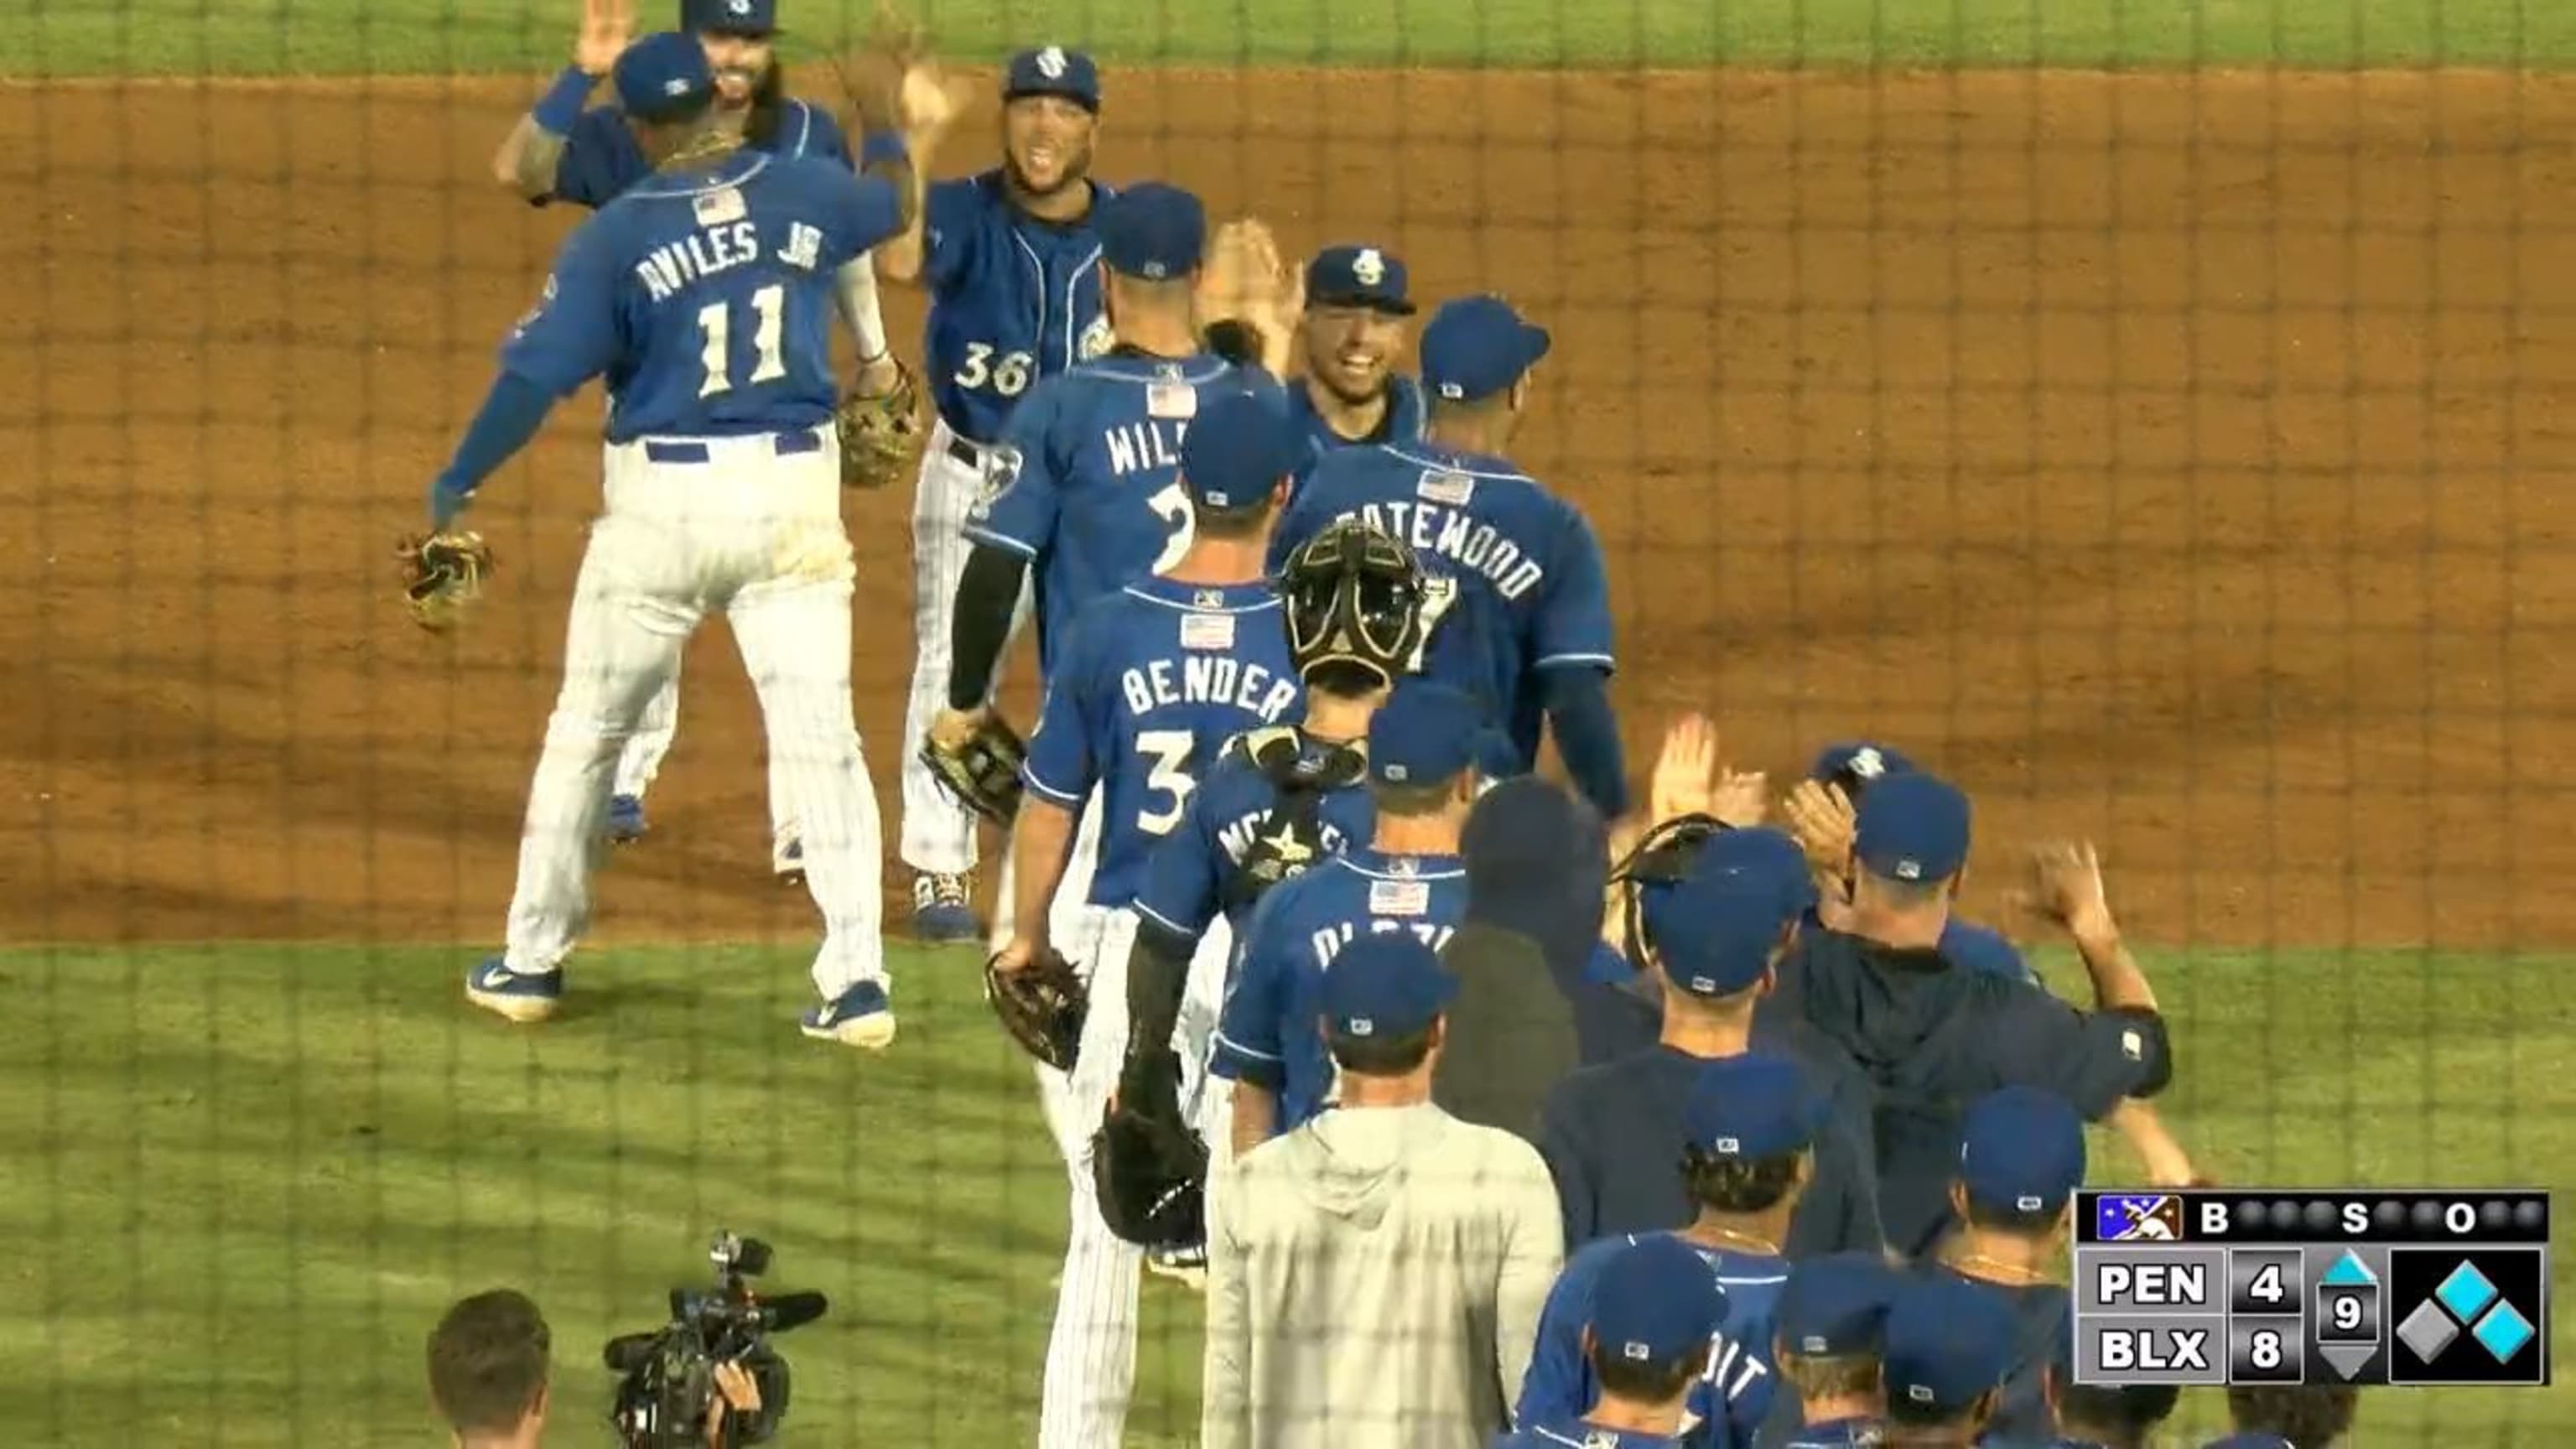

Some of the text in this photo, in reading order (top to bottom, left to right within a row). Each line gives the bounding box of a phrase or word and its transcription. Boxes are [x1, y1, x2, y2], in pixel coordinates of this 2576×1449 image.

[636, 221, 823, 304] AVILES JR
[697, 283, 787, 400] 11
[954, 340, 1033, 397] 36
[1104, 421, 1187, 475] WIL
[1122, 656, 1296, 724] BENDER
